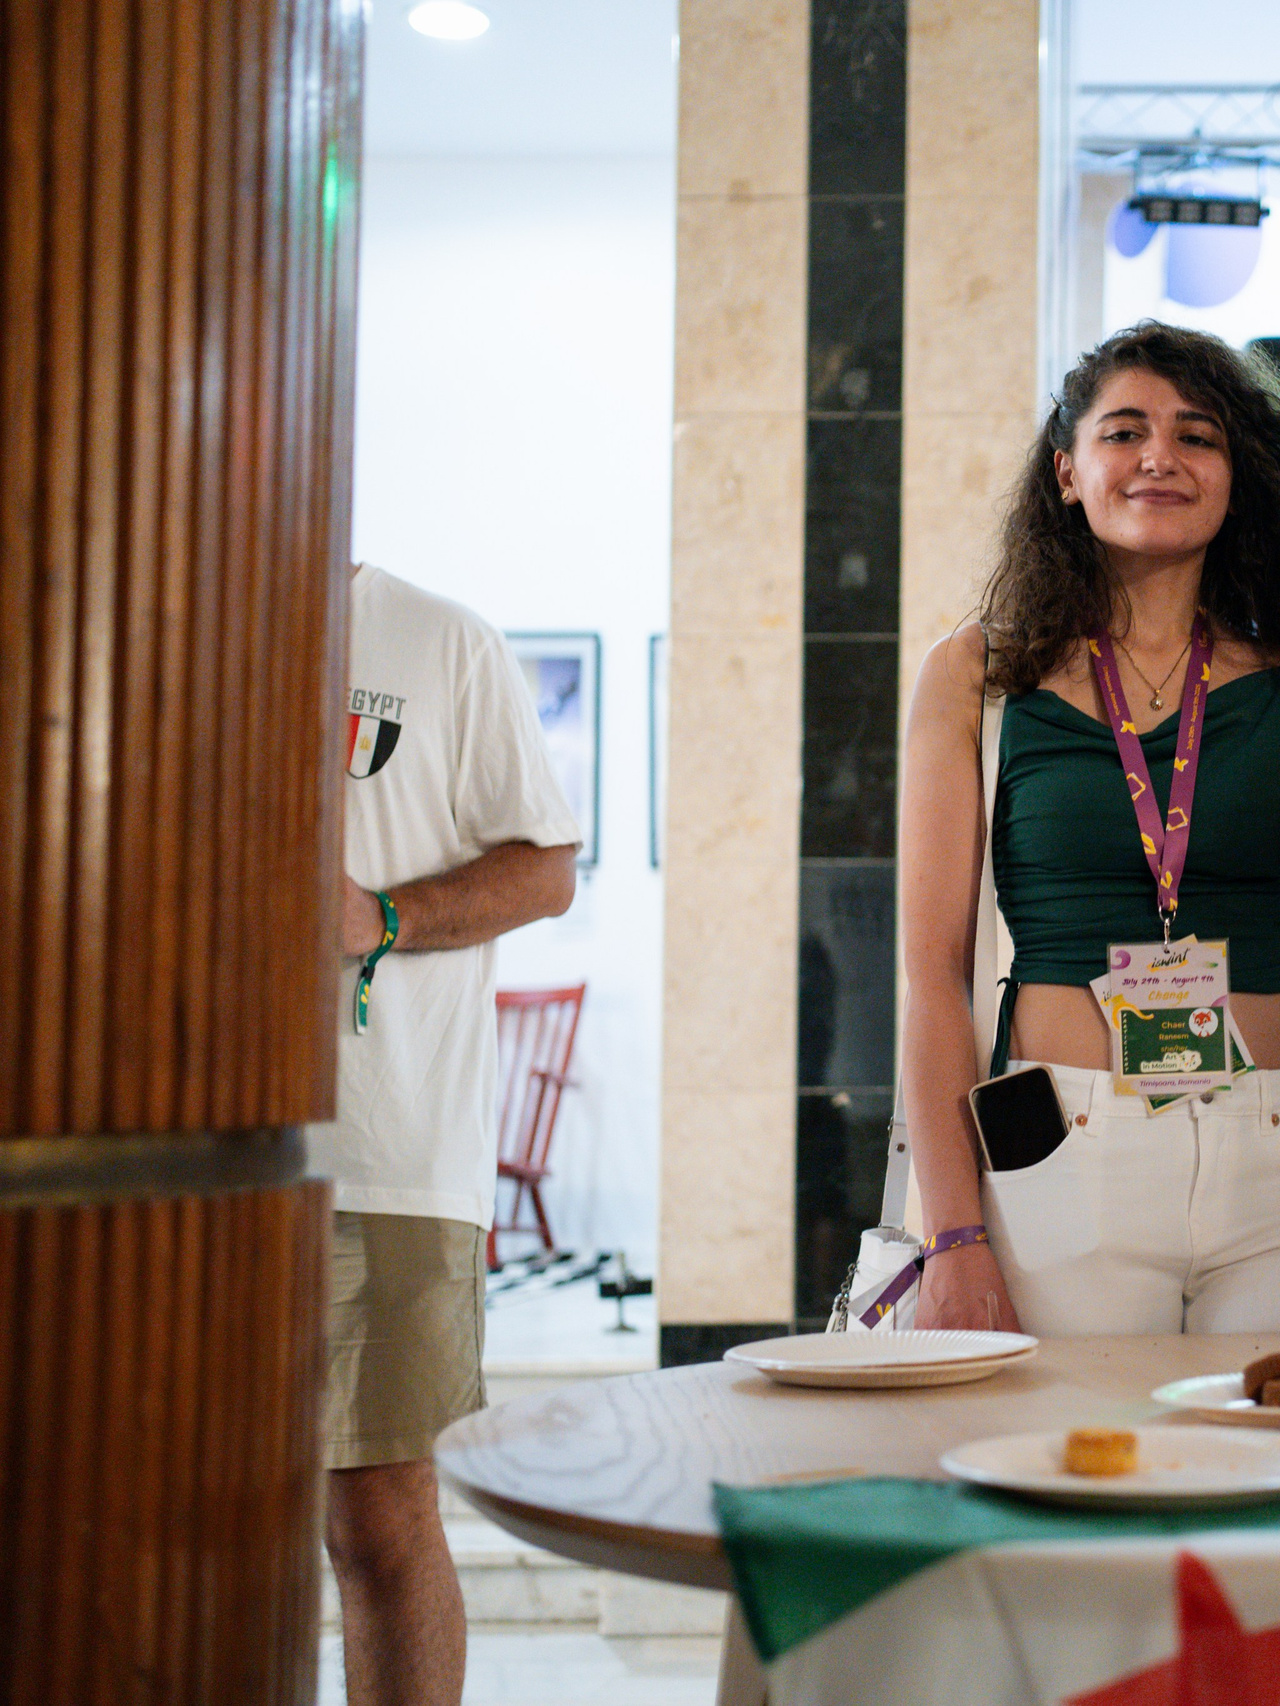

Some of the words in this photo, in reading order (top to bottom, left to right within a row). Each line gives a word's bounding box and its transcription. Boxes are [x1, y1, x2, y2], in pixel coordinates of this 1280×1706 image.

[348, 687, 406, 719] GYPT
[1122, 977, 1138, 989] July
[1171, 975, 1198, 988] August
[1148, 990, 1190, 1007] Change
